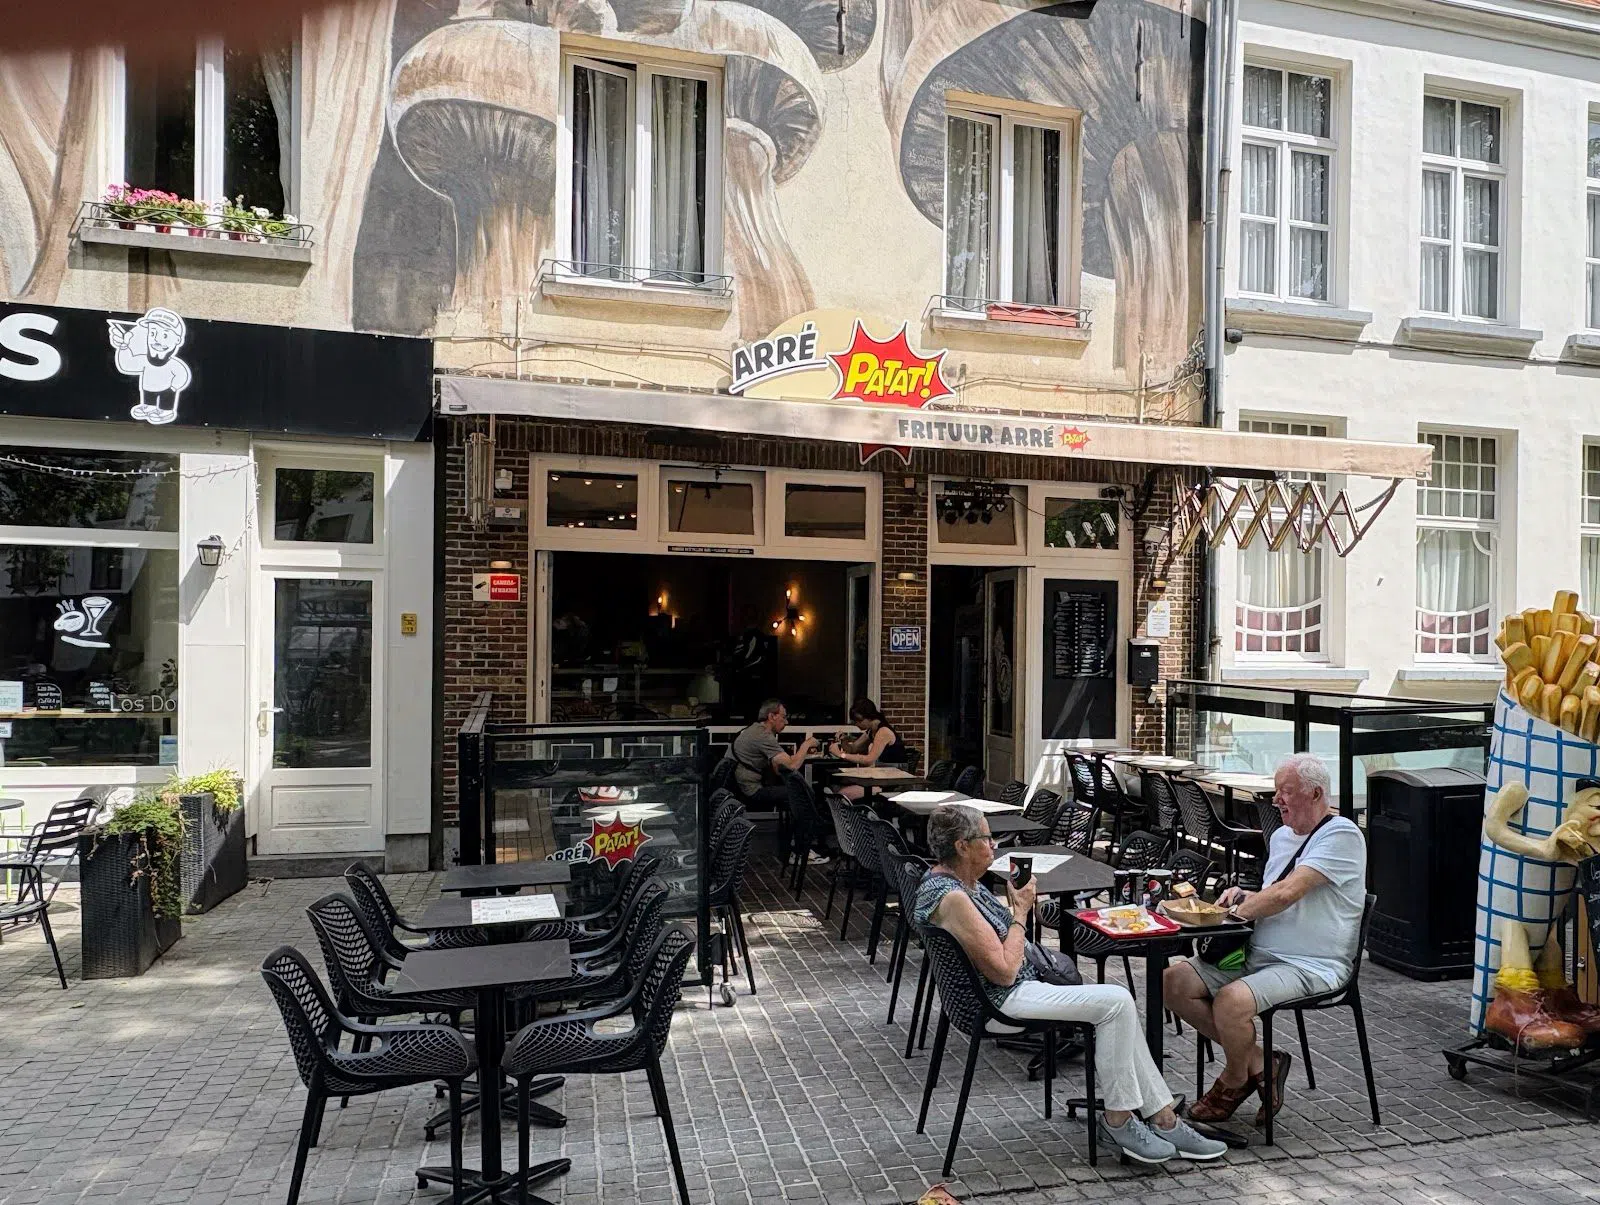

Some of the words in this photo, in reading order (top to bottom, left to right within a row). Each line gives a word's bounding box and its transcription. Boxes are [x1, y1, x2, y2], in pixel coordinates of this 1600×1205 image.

[735, 323, 817, 381] ARRÉ
[844, 352, 938, 398] PATAT!
[898, 419, 995, 444] FRITUUR
[1000, 425, 1054, 448] ARRÉ
[892, 632, 919, 647] OPEN
[111, 694, 144, 712] Los
[594, 826, 639, 856] PATAT!
